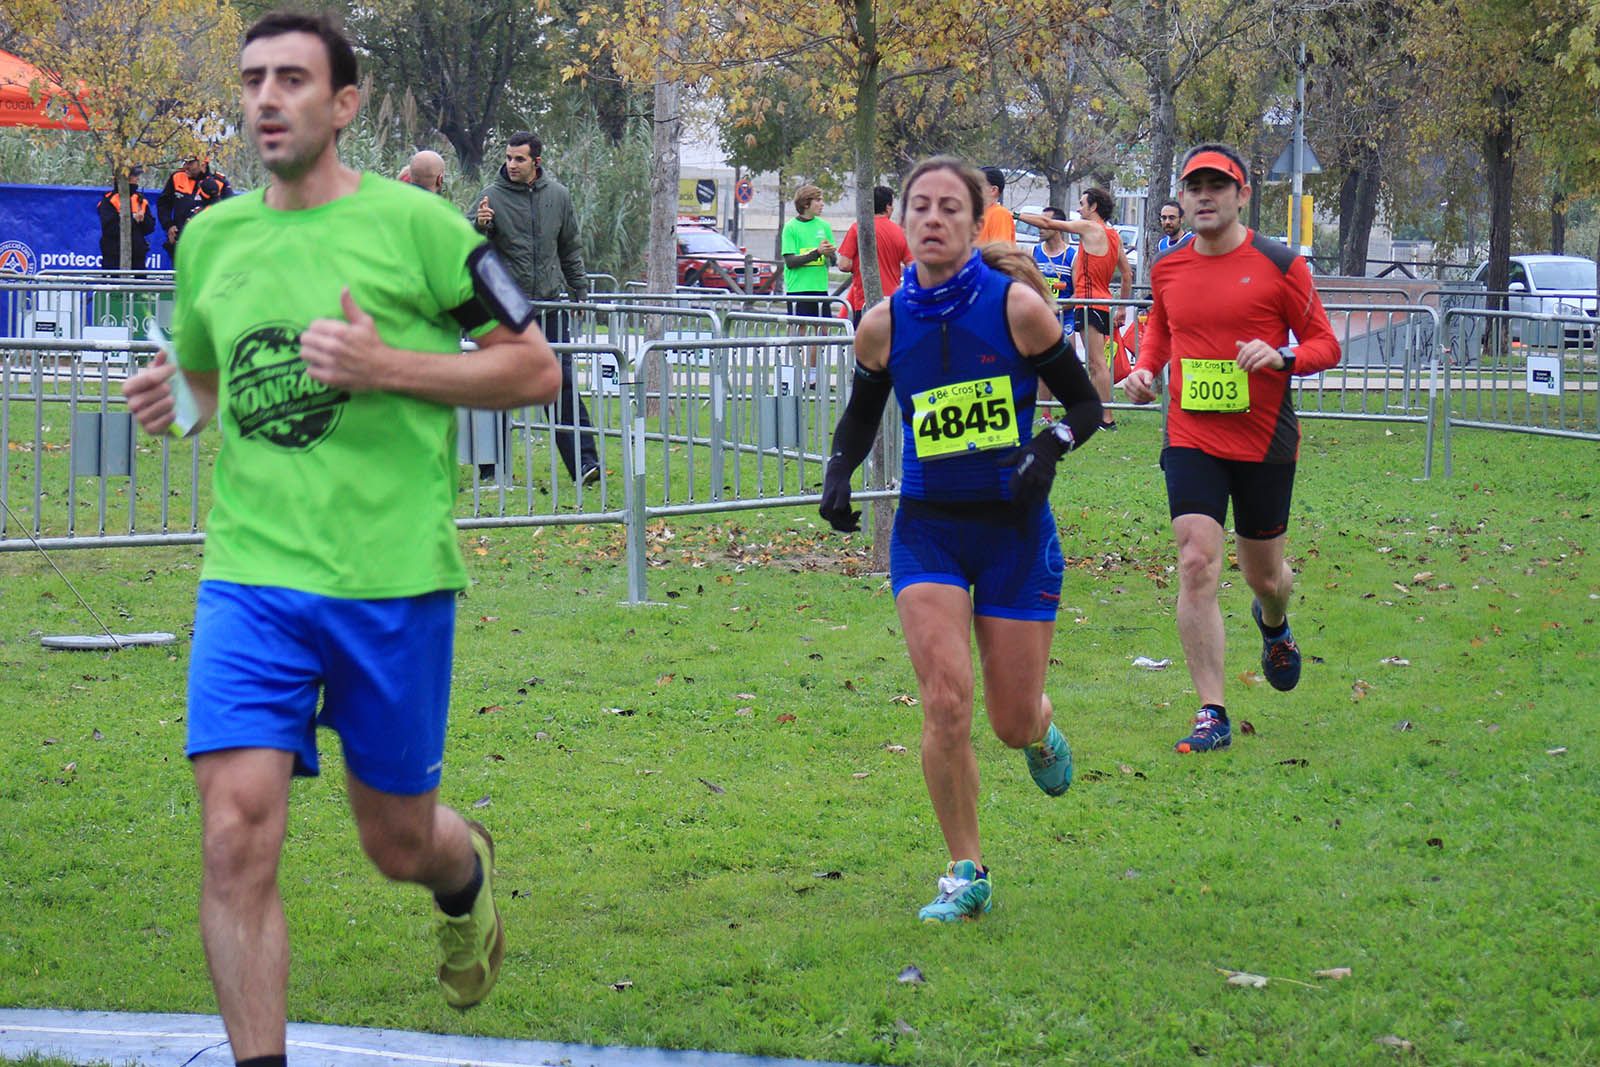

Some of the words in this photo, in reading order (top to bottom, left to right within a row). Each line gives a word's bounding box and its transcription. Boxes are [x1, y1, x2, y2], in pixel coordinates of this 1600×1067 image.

[41, 252, 103, 269] protecc
[1204, 361, 1220, 369] Cros
[951, 385, 974, 396] Cros
[1189, 381, 1238, 400] 5003
[919, 398, 1010, 441] 4845
